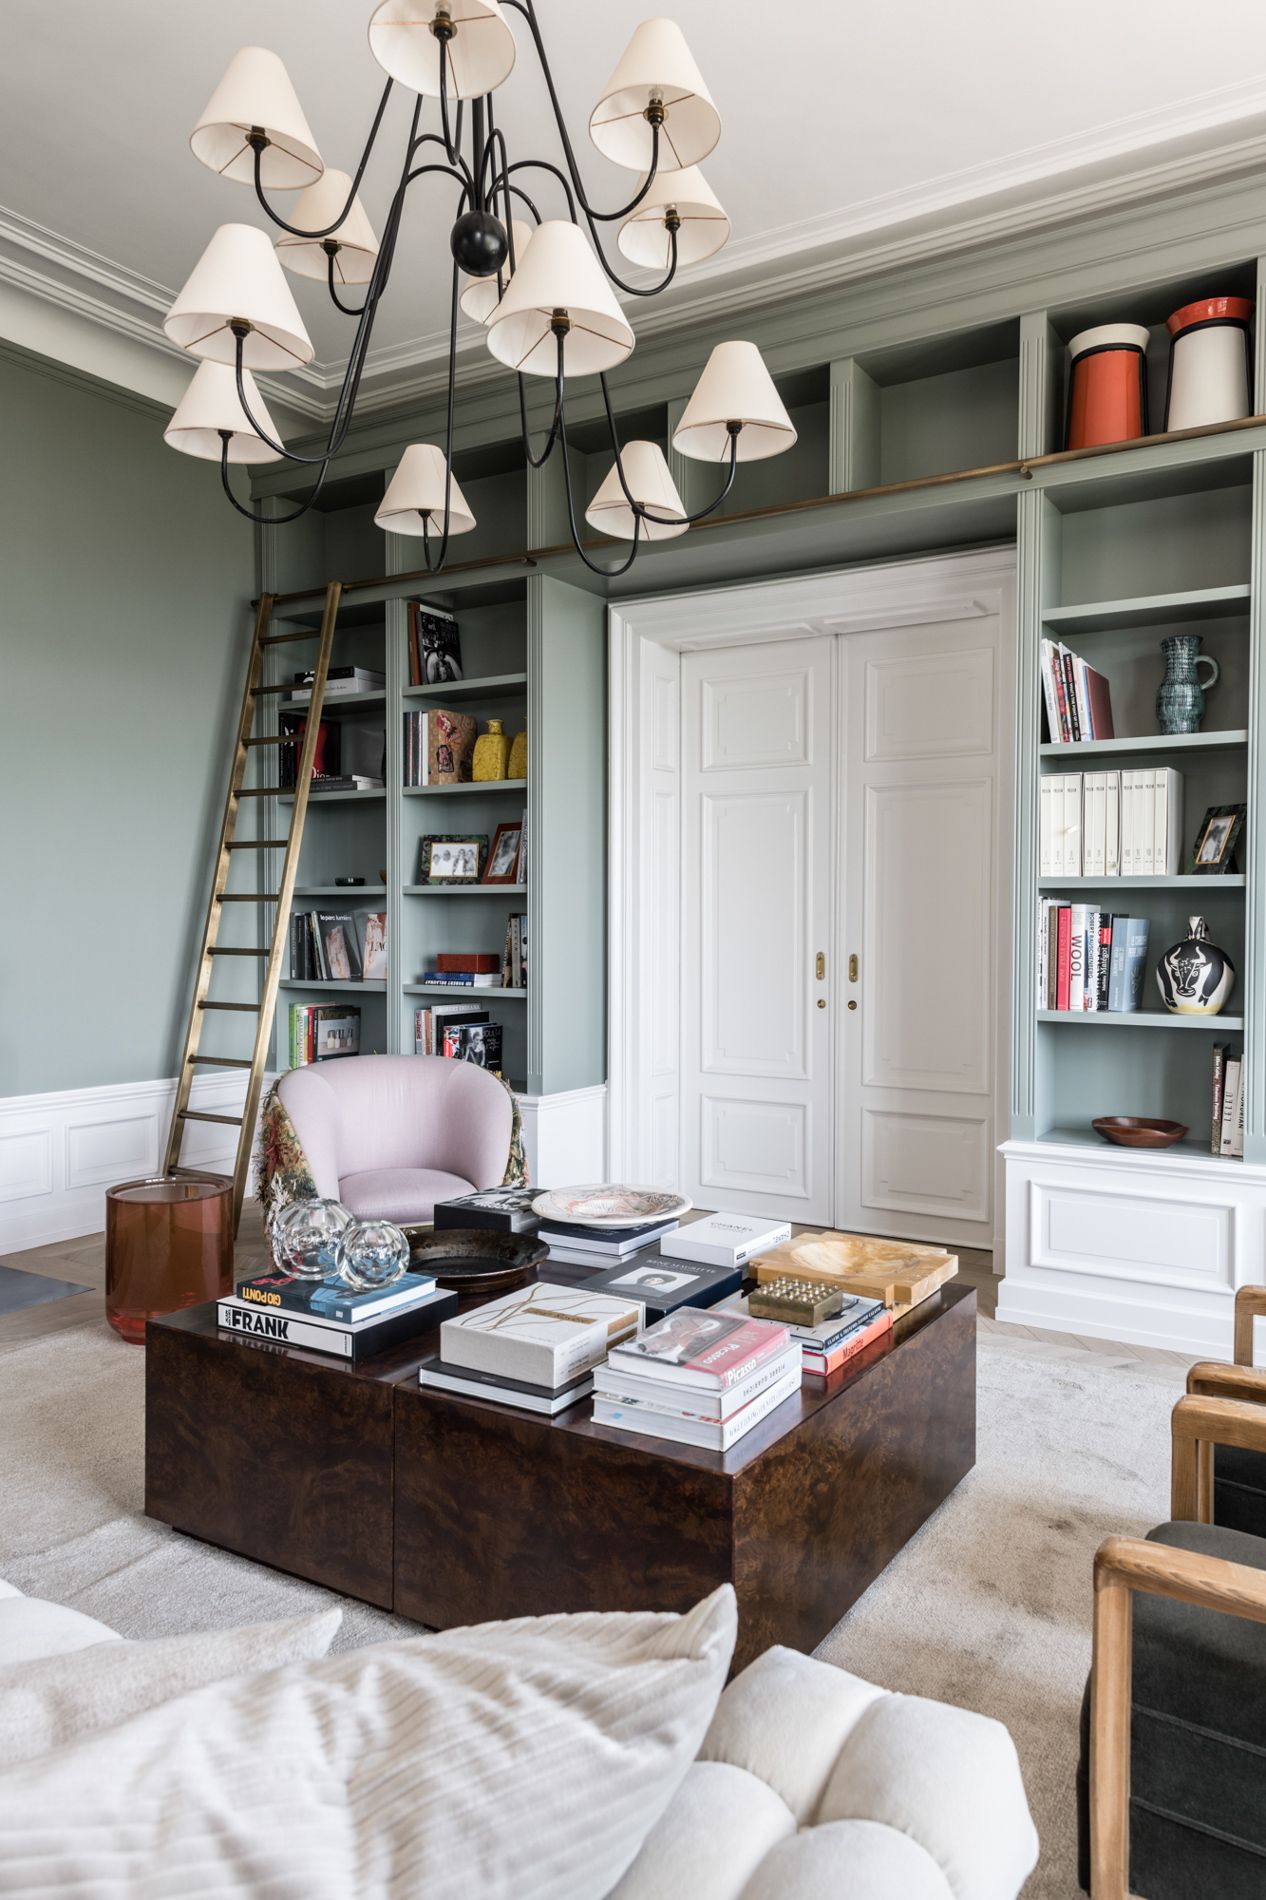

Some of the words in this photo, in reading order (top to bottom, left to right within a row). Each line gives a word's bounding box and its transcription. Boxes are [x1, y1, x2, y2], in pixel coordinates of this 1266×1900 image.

[1070, 934, 1082, 981] WOOL
[242, 1286, 268, 1304] PONTI
[267, 1292, 282, 1307] GIO
[232, 1308, 290, 1340] FRANK
[727, 1357, 757, 1387] Picasso
